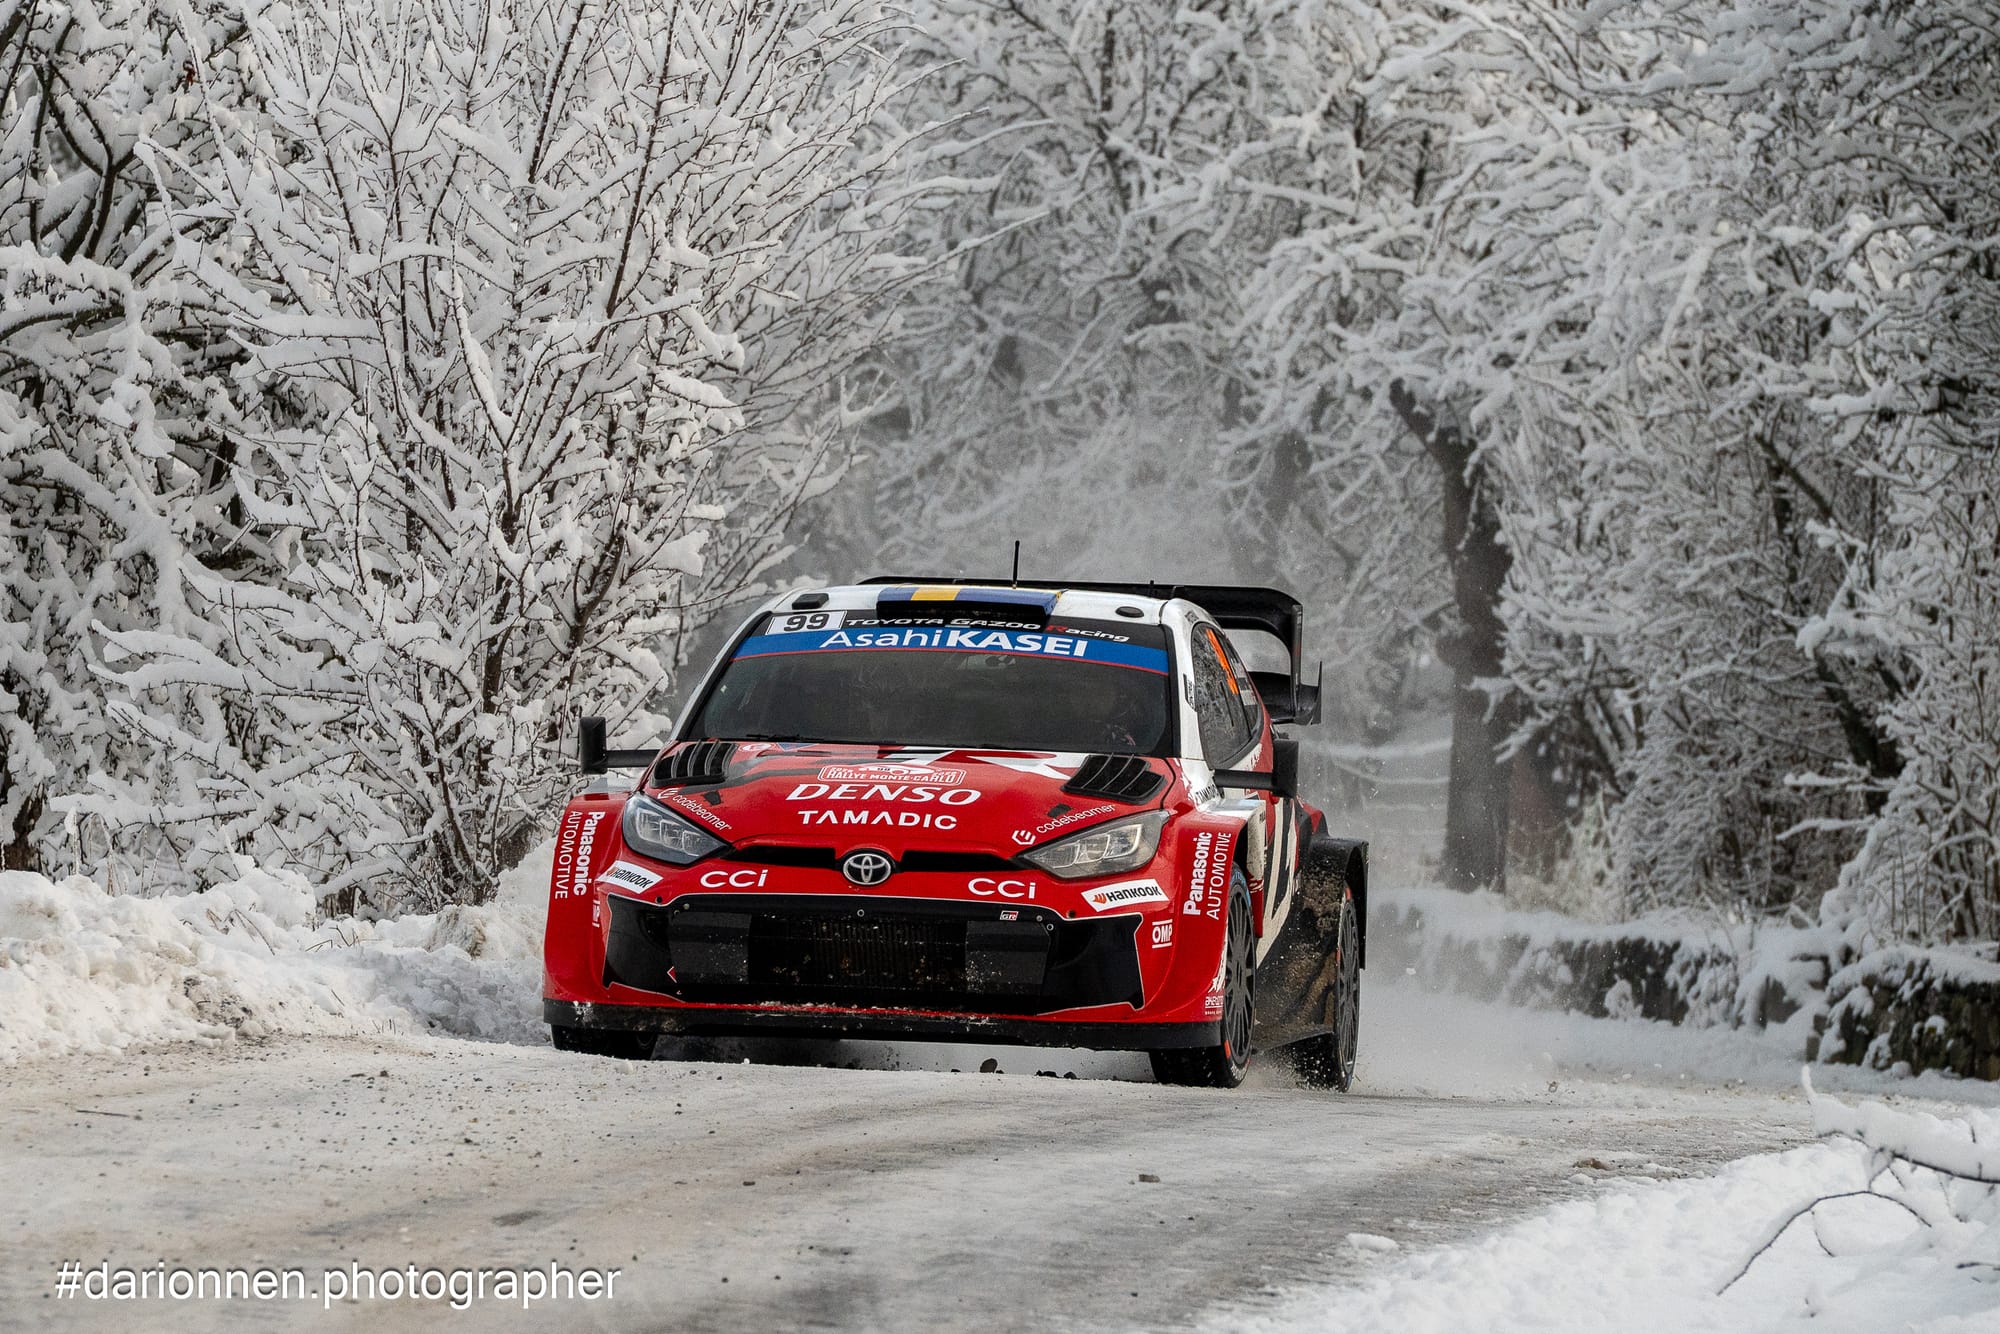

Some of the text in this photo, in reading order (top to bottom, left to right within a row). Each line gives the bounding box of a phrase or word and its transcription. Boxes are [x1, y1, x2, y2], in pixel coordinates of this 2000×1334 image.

[783, 613, 830, 632] 99
[846, 618, 1130, 643] TOYOTA GAZOO Racing
[819, 629, 1089, 657] AsahiKASEI
[785, 783, 981, 806] DENSO
[672, 794, 731, 831] codebeamer
[798, 810, 958, 831] TAMADIC
[1036, 803, 1117, 834] codebeamer
[555, 810, 583, 900] AUTOMOTIVE
[573, 811, 606, 896] Panasonic
[1183, 831, 1213, 916] Panasonic
[1206, 832, 1232, 920] AUTOMOTIVE
[1152, 924, 1173, 944] OMP
